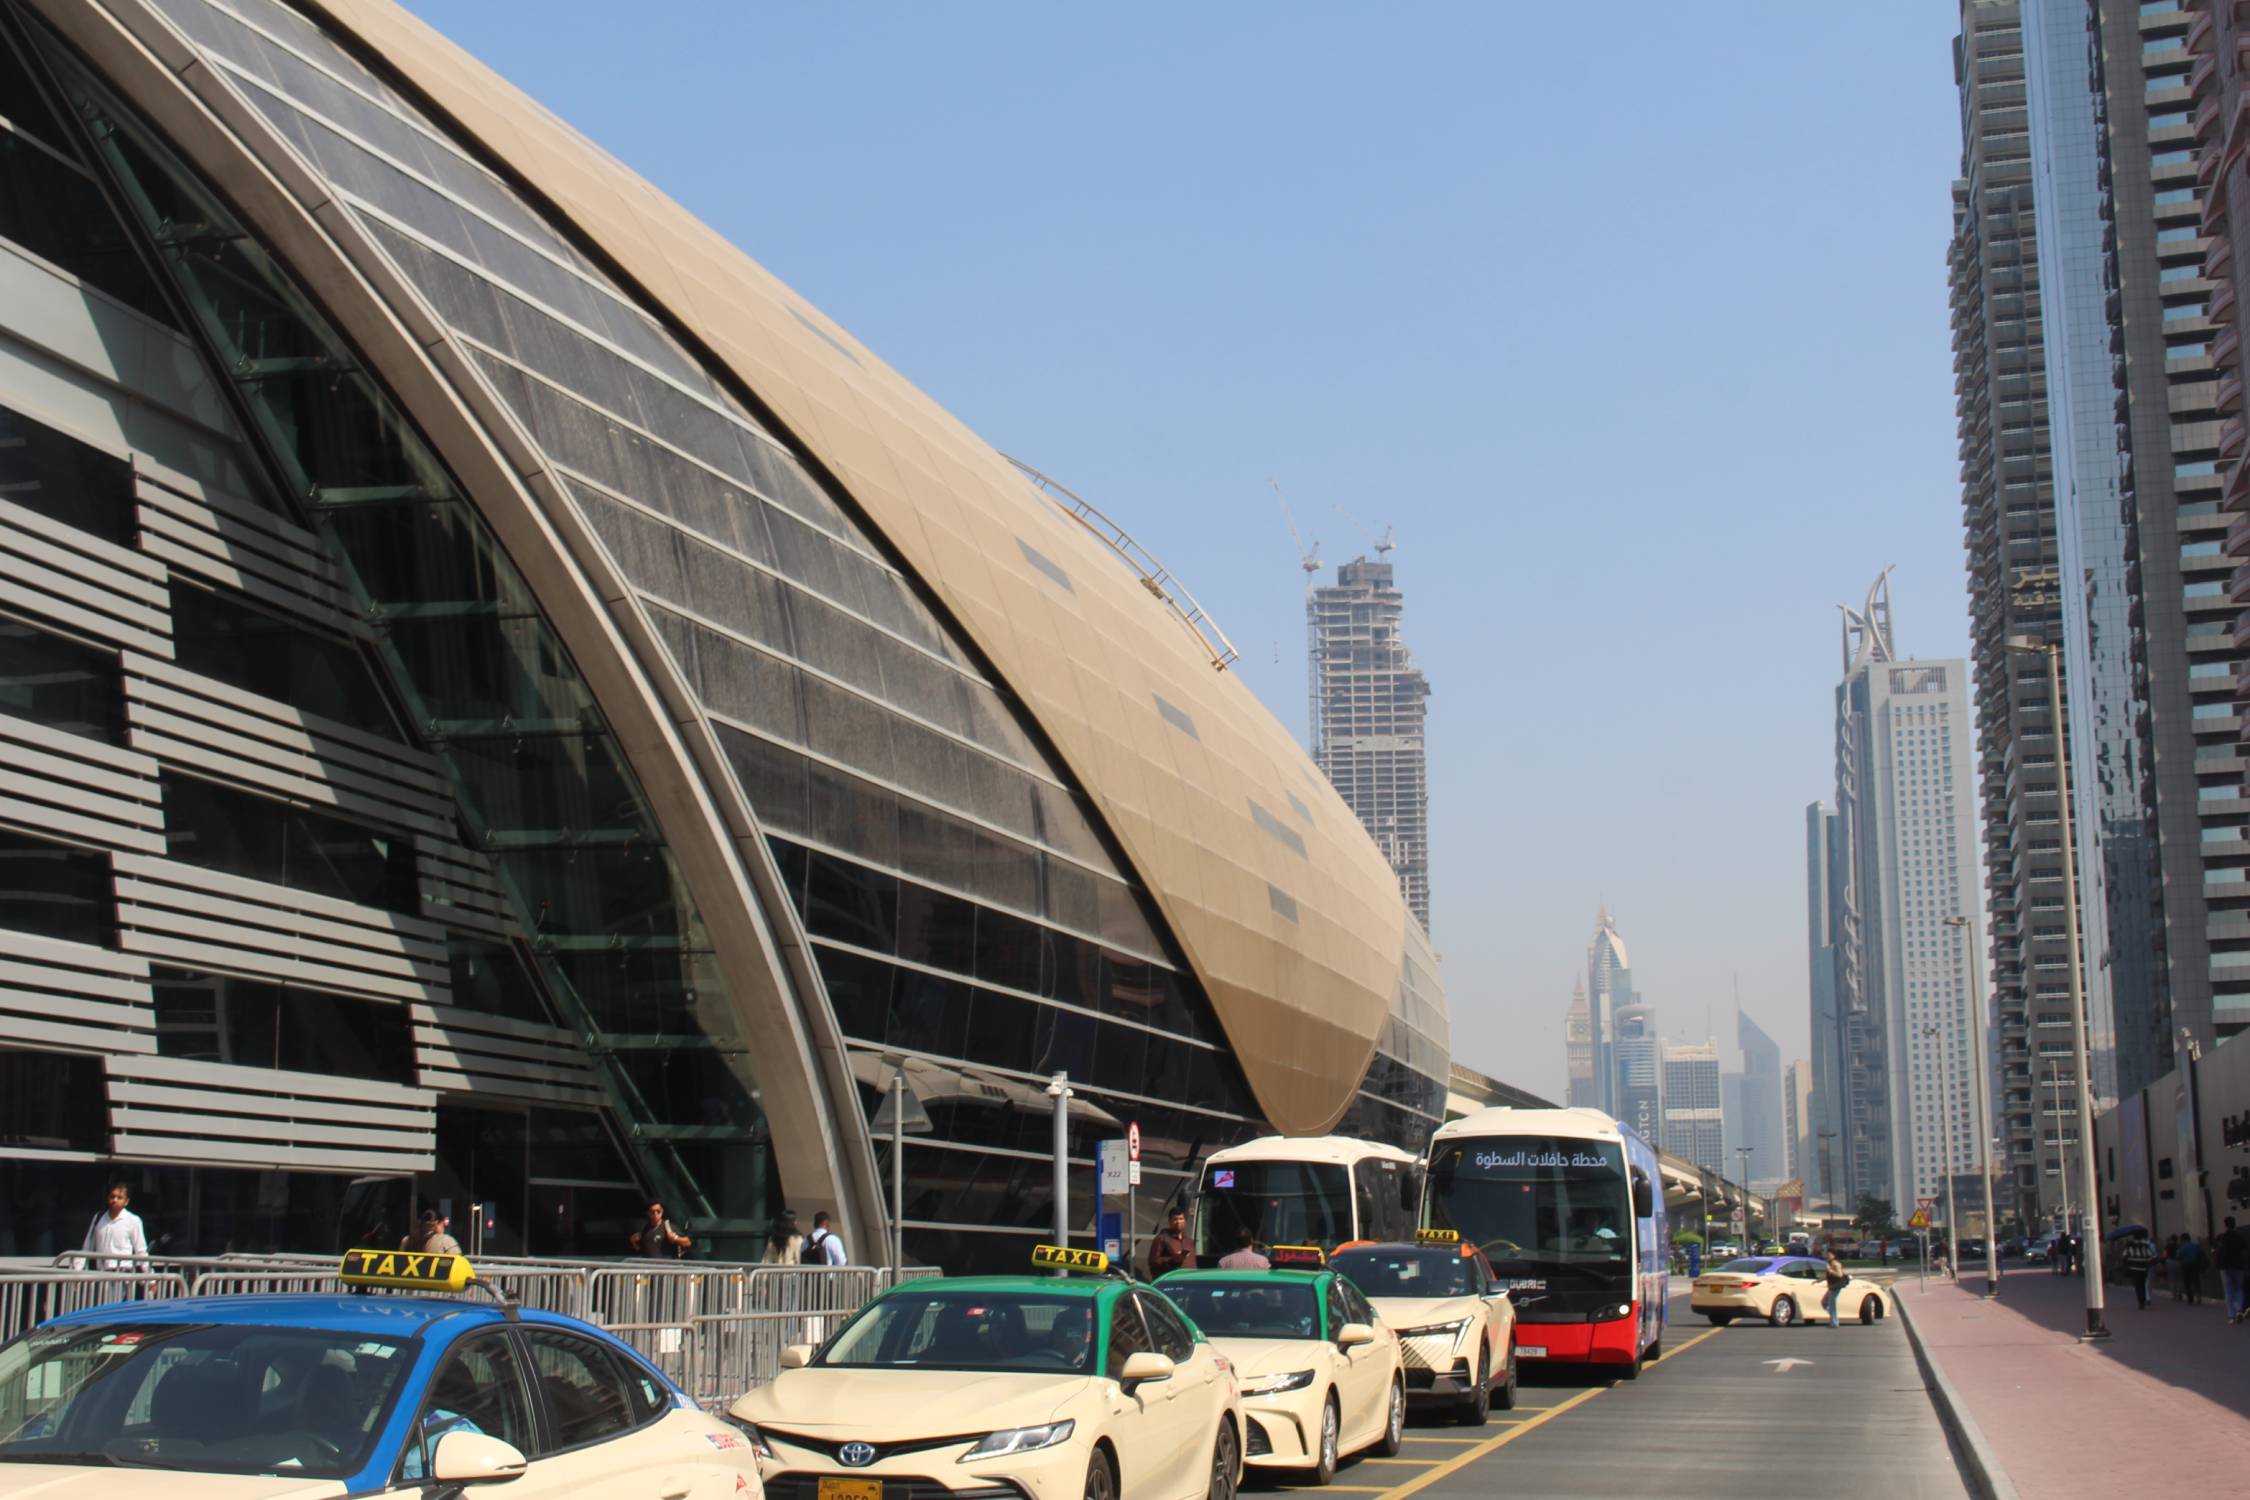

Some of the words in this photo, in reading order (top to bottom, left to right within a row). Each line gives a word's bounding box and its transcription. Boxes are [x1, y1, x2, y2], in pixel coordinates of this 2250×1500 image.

[1454, 1151, 1463, 1167] 7
[1475, 1152, 1525, 1169] السطوة
[1527, 1152, 1569, 1167] حافلات
[1571, 1152, 1608, 1167] محطة
[1044, 1248, 1093, 1265] TAXI
[360, 1253, 440, 1278] TAXI
